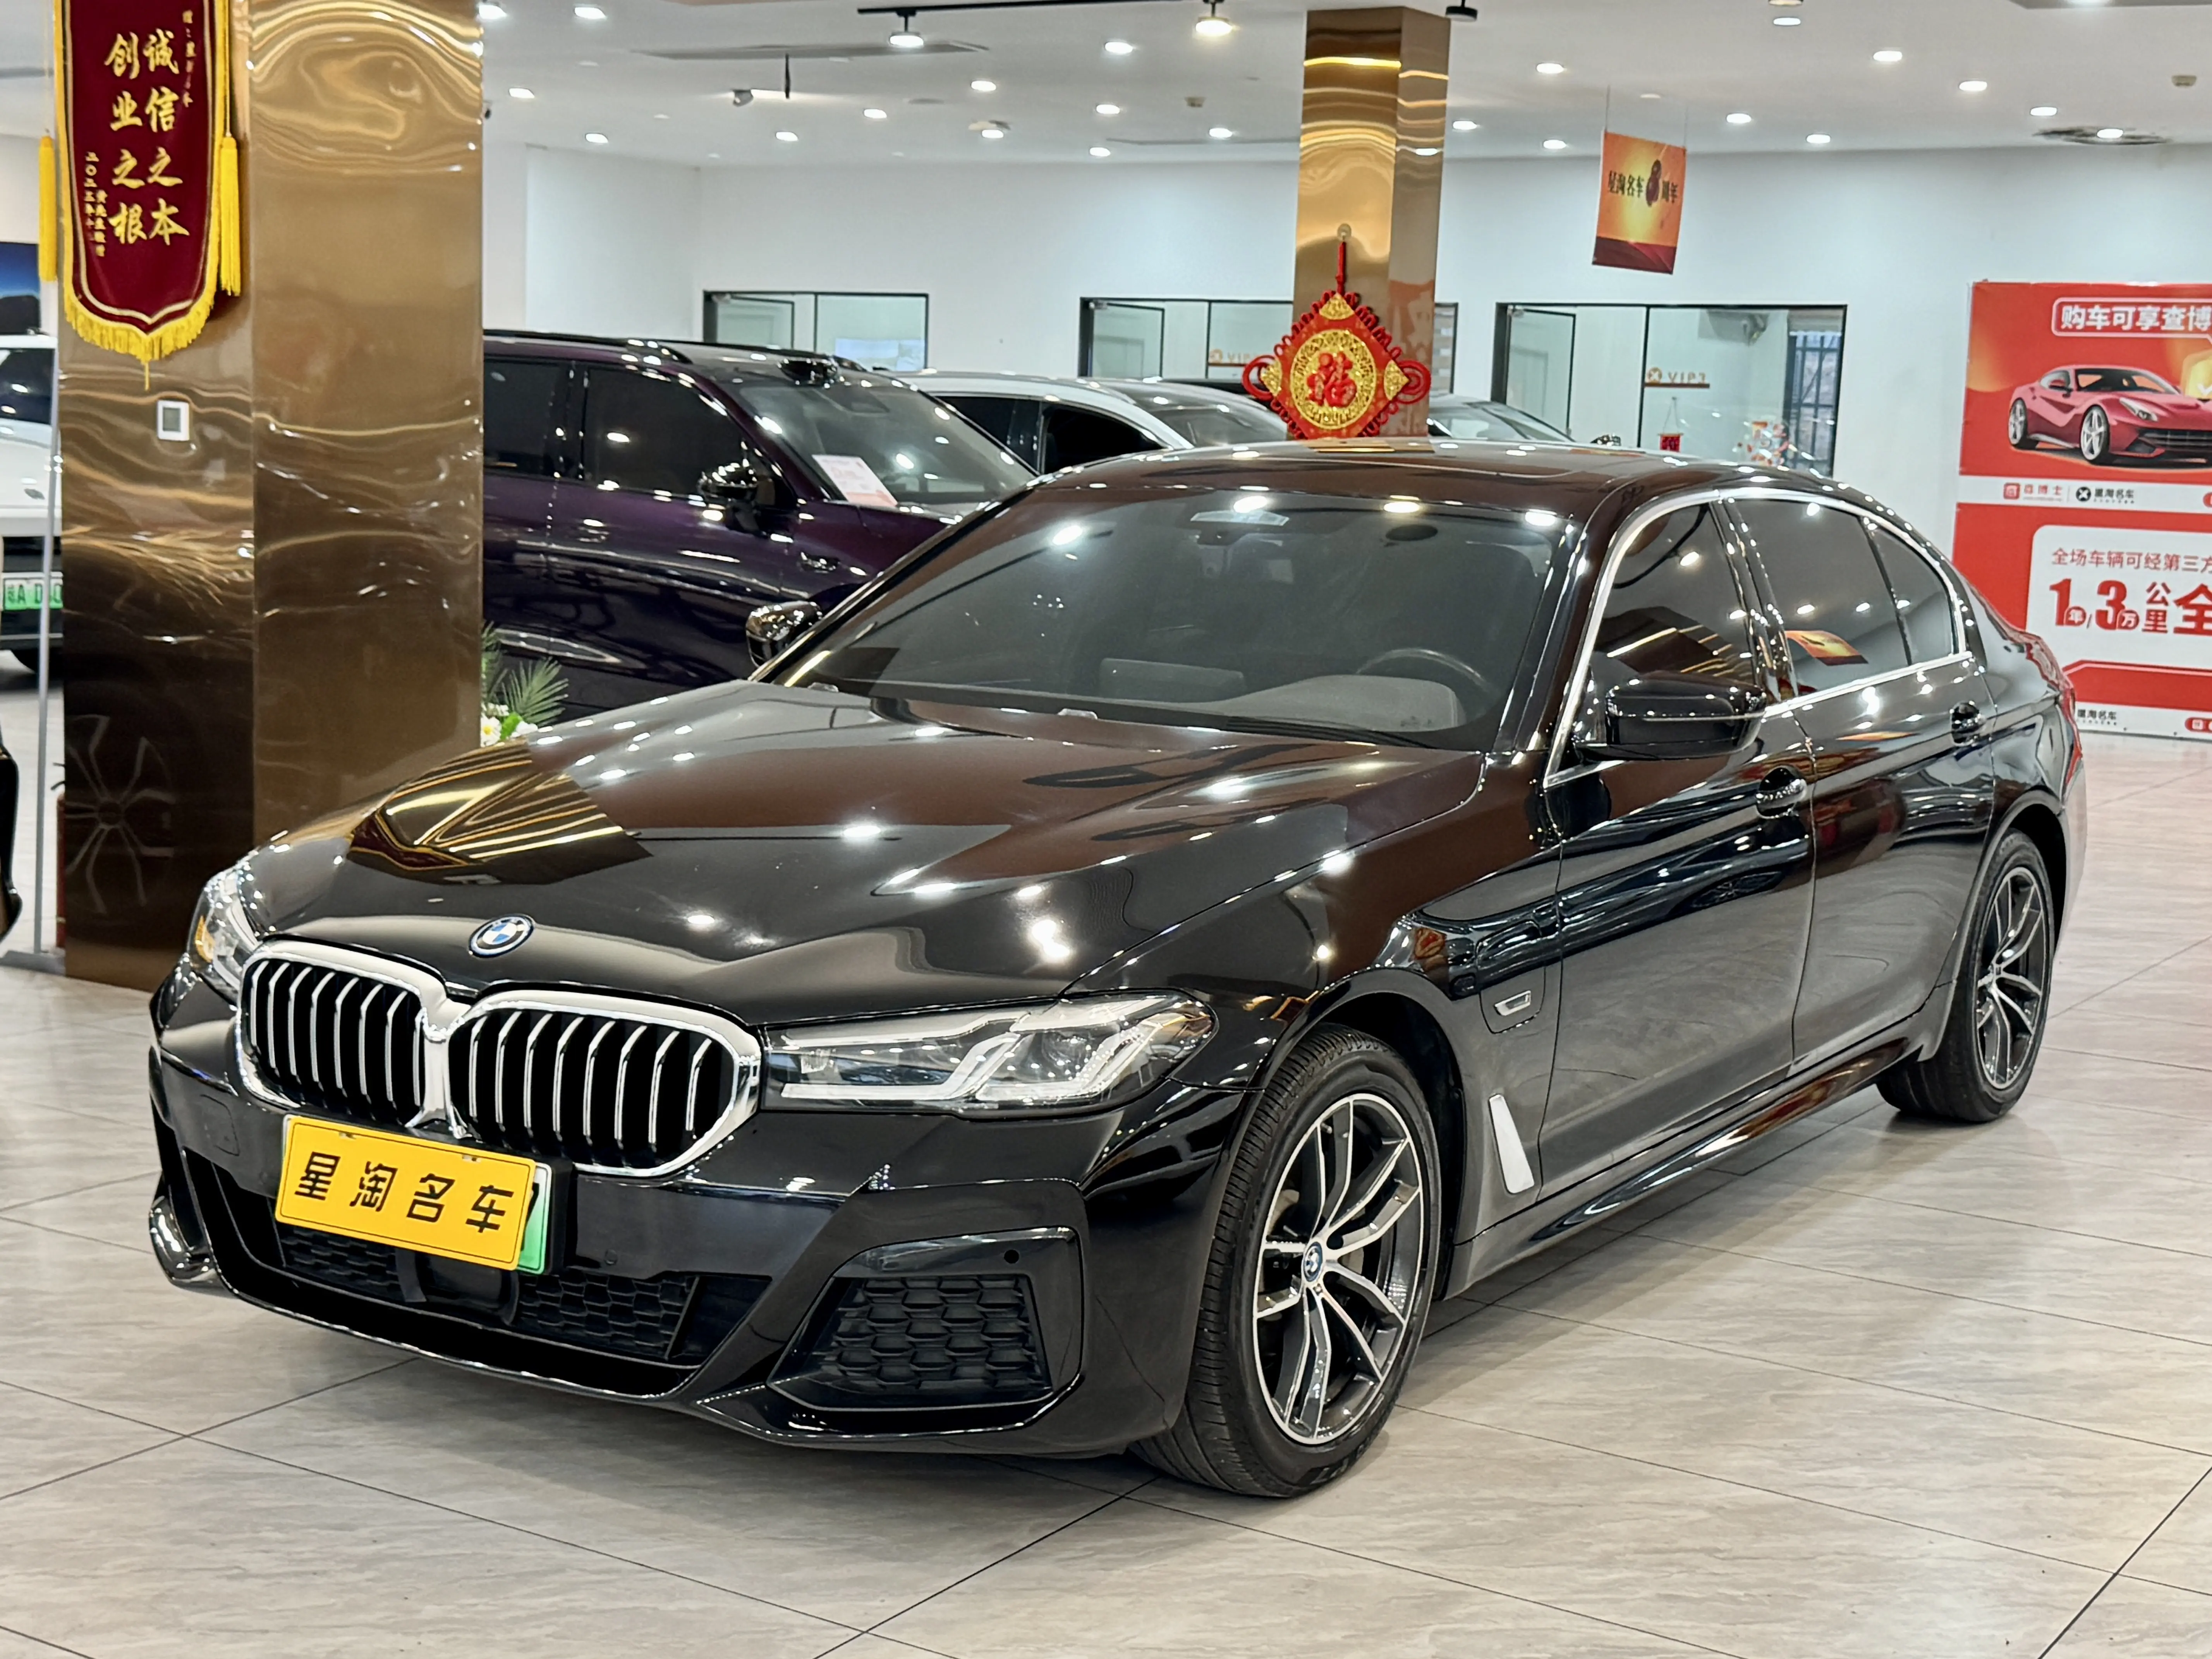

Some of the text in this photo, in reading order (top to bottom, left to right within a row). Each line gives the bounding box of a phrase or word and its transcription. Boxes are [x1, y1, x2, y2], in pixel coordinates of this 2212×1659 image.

[105, 32, 147, 244] 创业之根
[143, 28, 190, 245] 诚信之本
[1307, 351, 1357, 408] 福
[2052, 548, 2212, 573] 全场车辆可经第三方
[294, 1151, 514, 1233] 星淘名车
